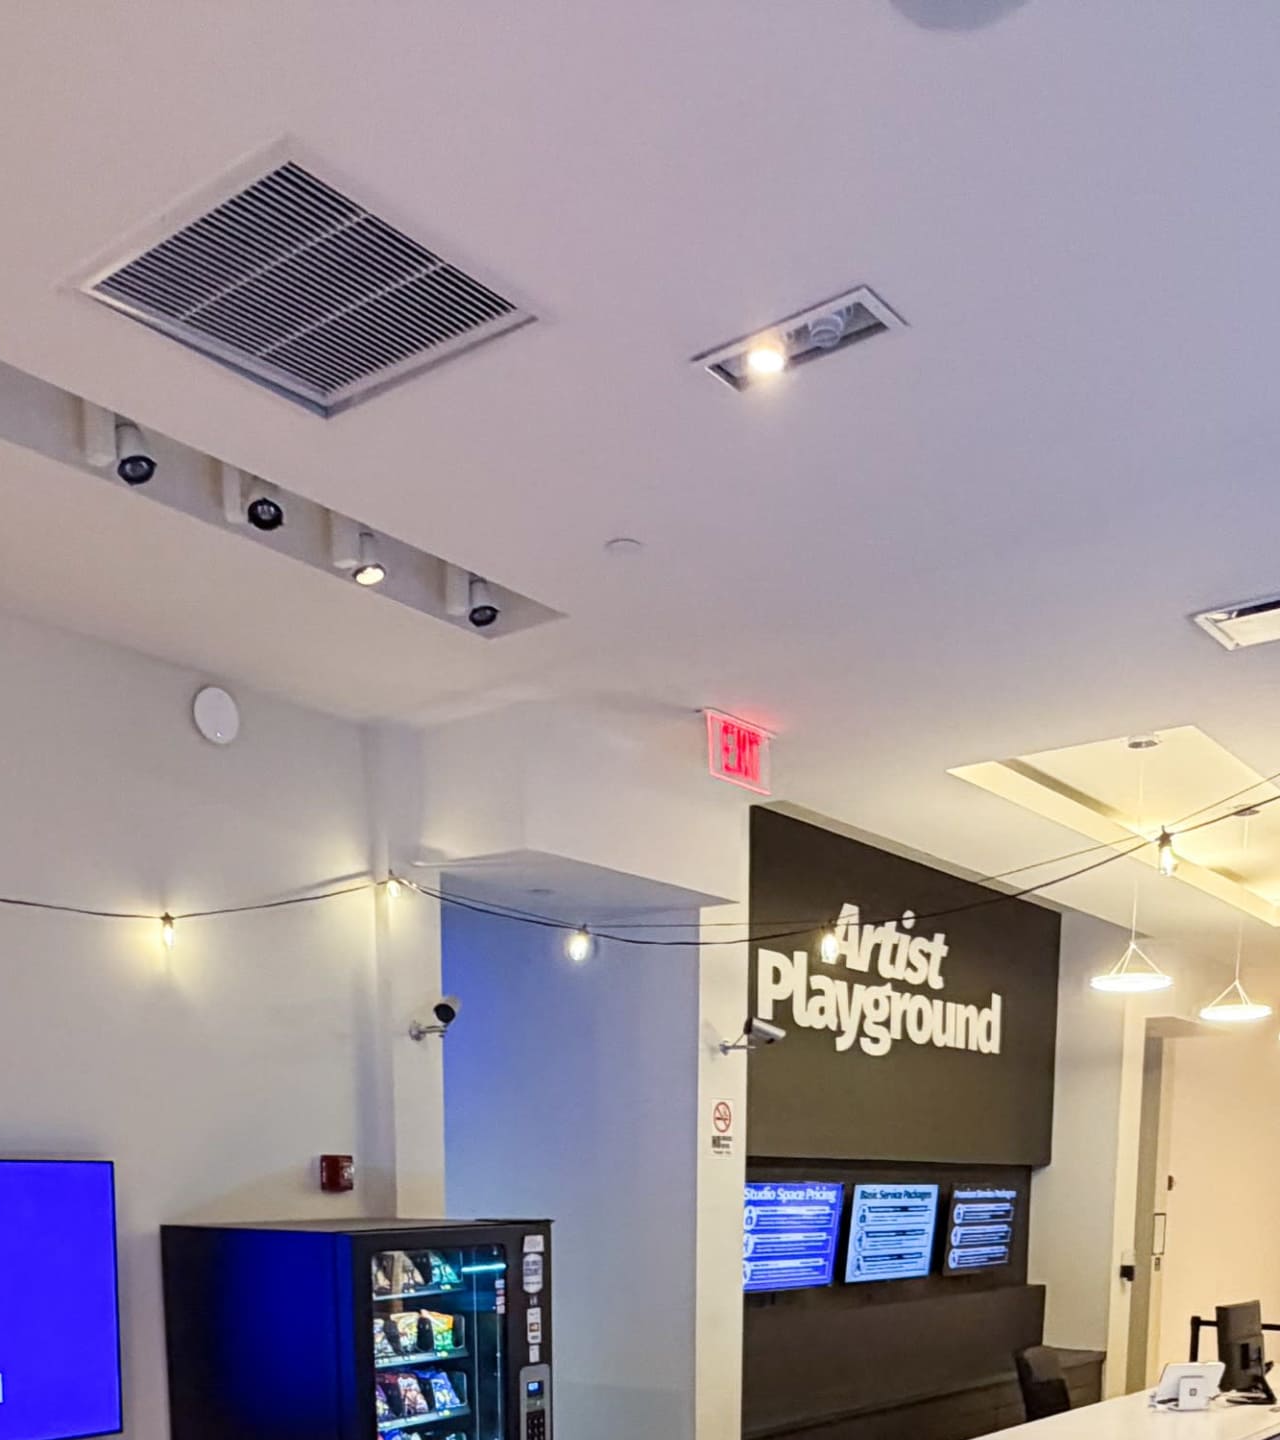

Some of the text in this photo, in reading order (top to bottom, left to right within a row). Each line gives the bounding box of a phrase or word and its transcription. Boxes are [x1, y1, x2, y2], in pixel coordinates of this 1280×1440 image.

[721, 720, 761, 785] EXIT
[821, 902, 949, 990] Artist
[757, 947, 1002, 1056] Playground
[777, 1187, 805, 1203] Space
[806, 1186, 837, 1203] Pricing
